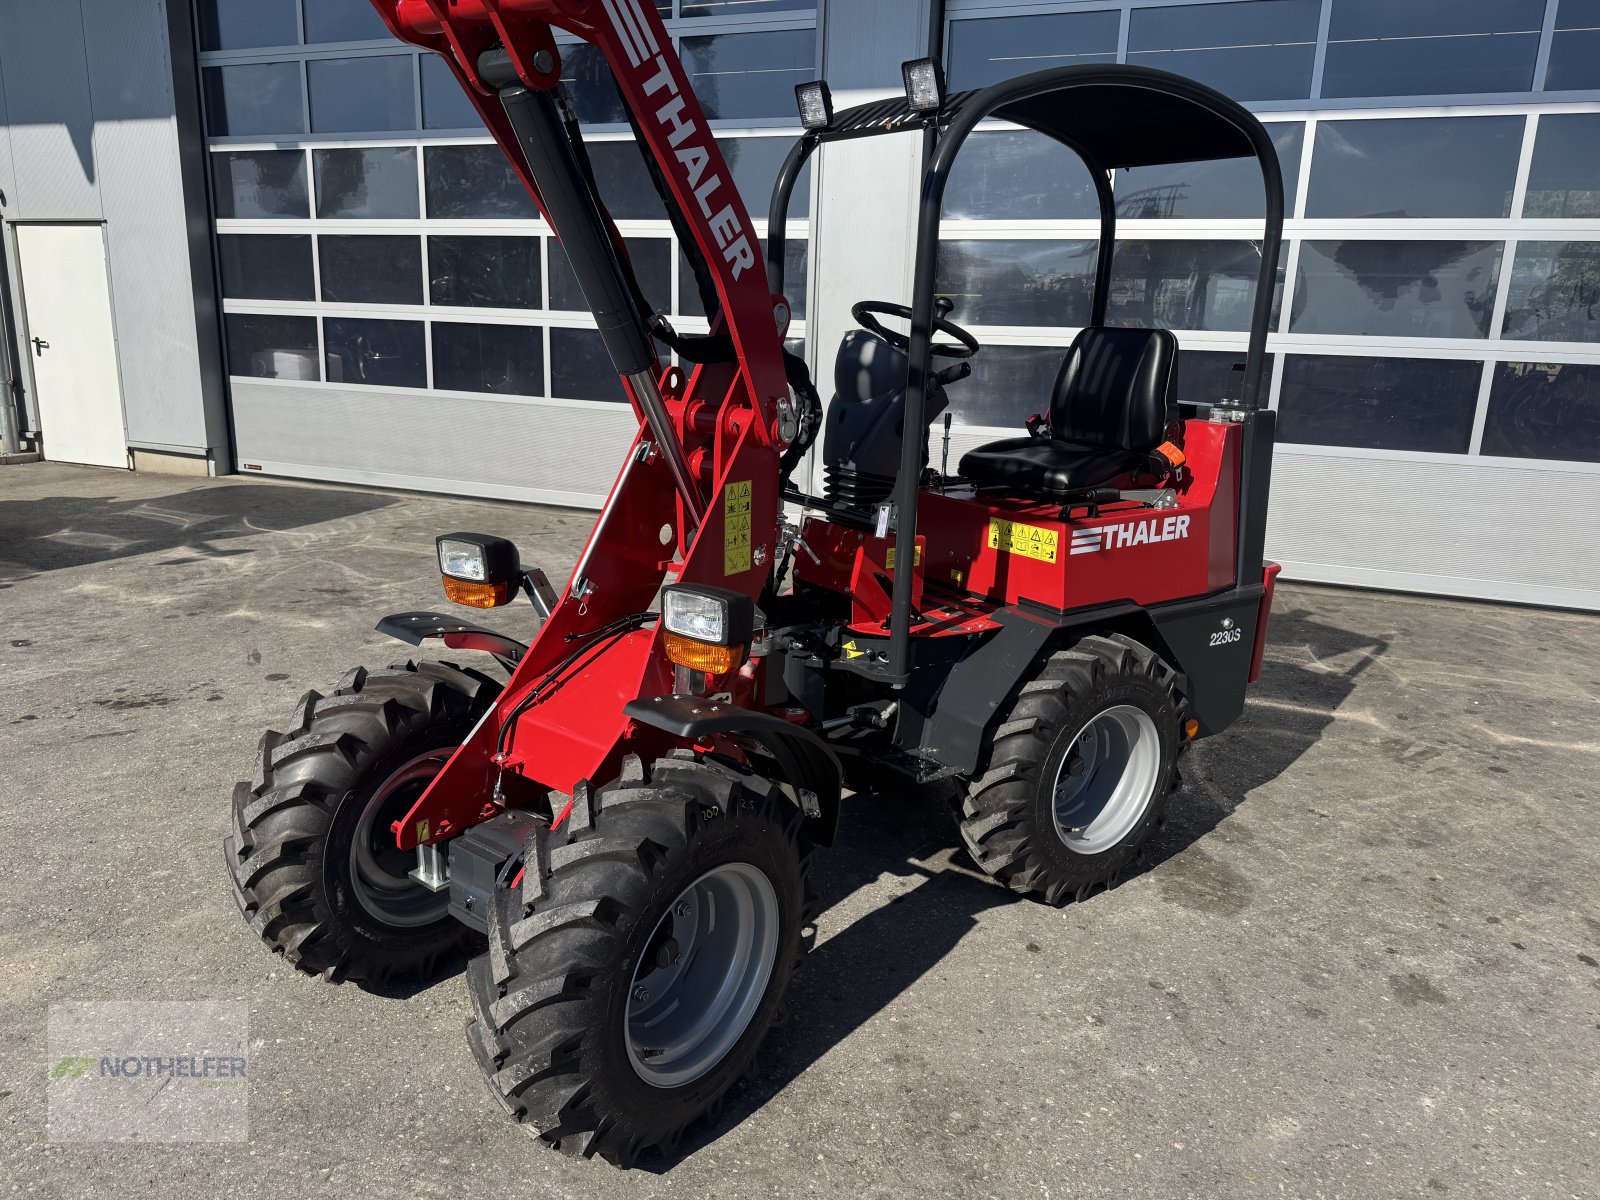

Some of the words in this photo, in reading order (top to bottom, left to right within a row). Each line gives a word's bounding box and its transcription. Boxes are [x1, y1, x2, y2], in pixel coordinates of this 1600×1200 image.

[642, 54, 755, 282] THALER
[1103, 515, 1191, 549] THALER
[1209, 628, 1241, 646] 2230S
